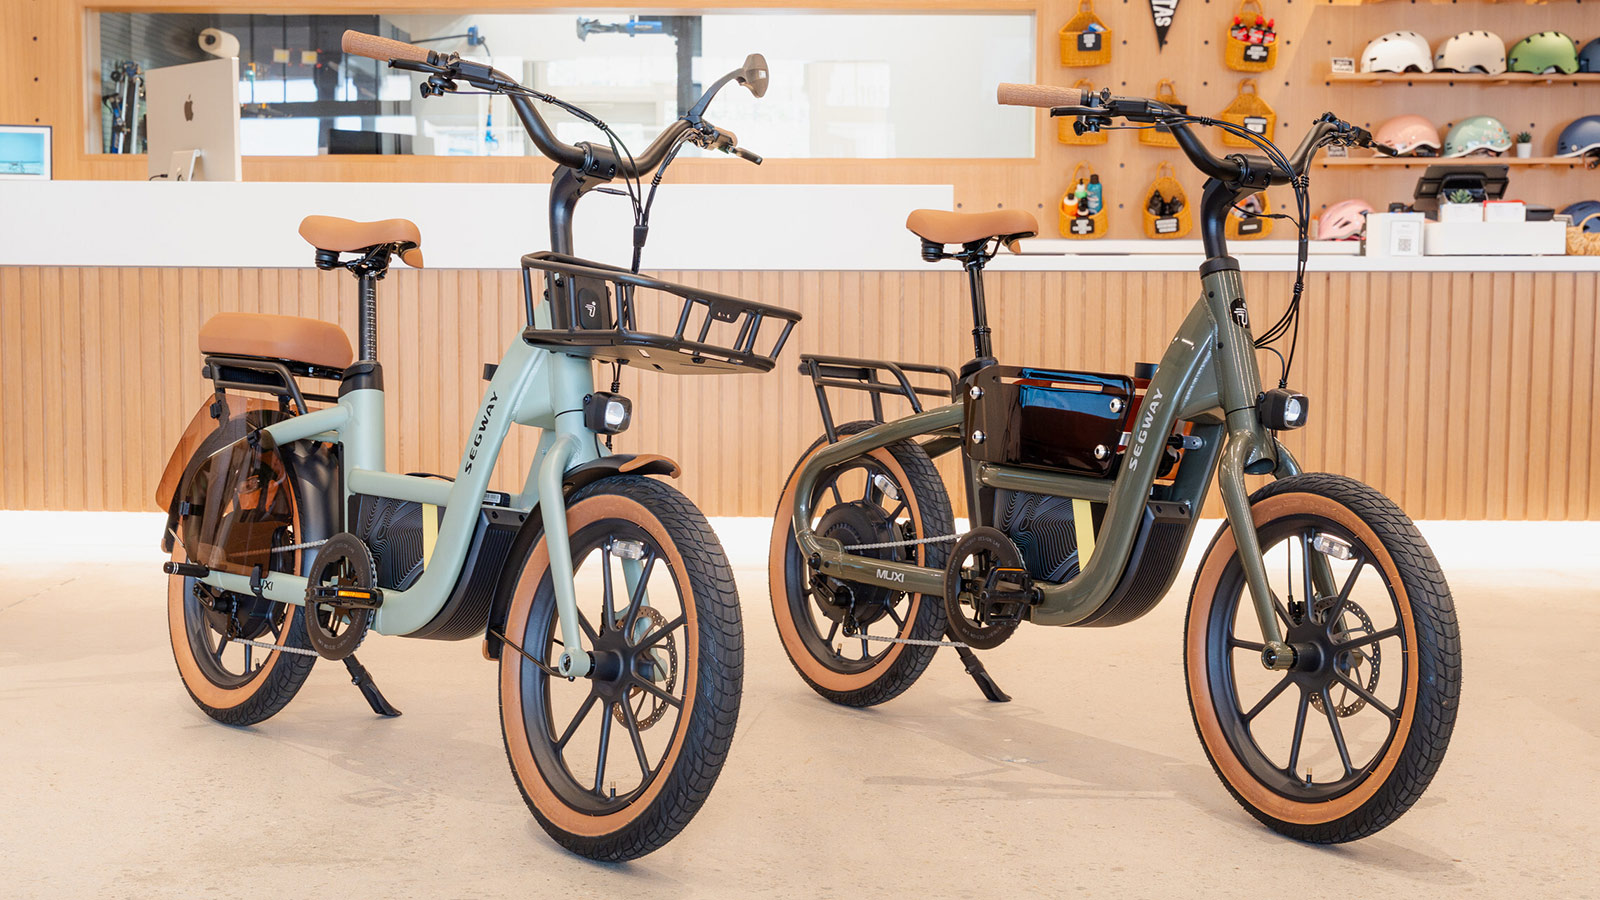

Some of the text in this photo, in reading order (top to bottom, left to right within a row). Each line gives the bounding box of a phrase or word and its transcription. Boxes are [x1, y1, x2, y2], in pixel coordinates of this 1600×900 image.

[464, 391, 498, 475] SEGWAY
[1128, 387, 1163, 472] SEGWAY
[876, 568, 905, 583] MUXI
